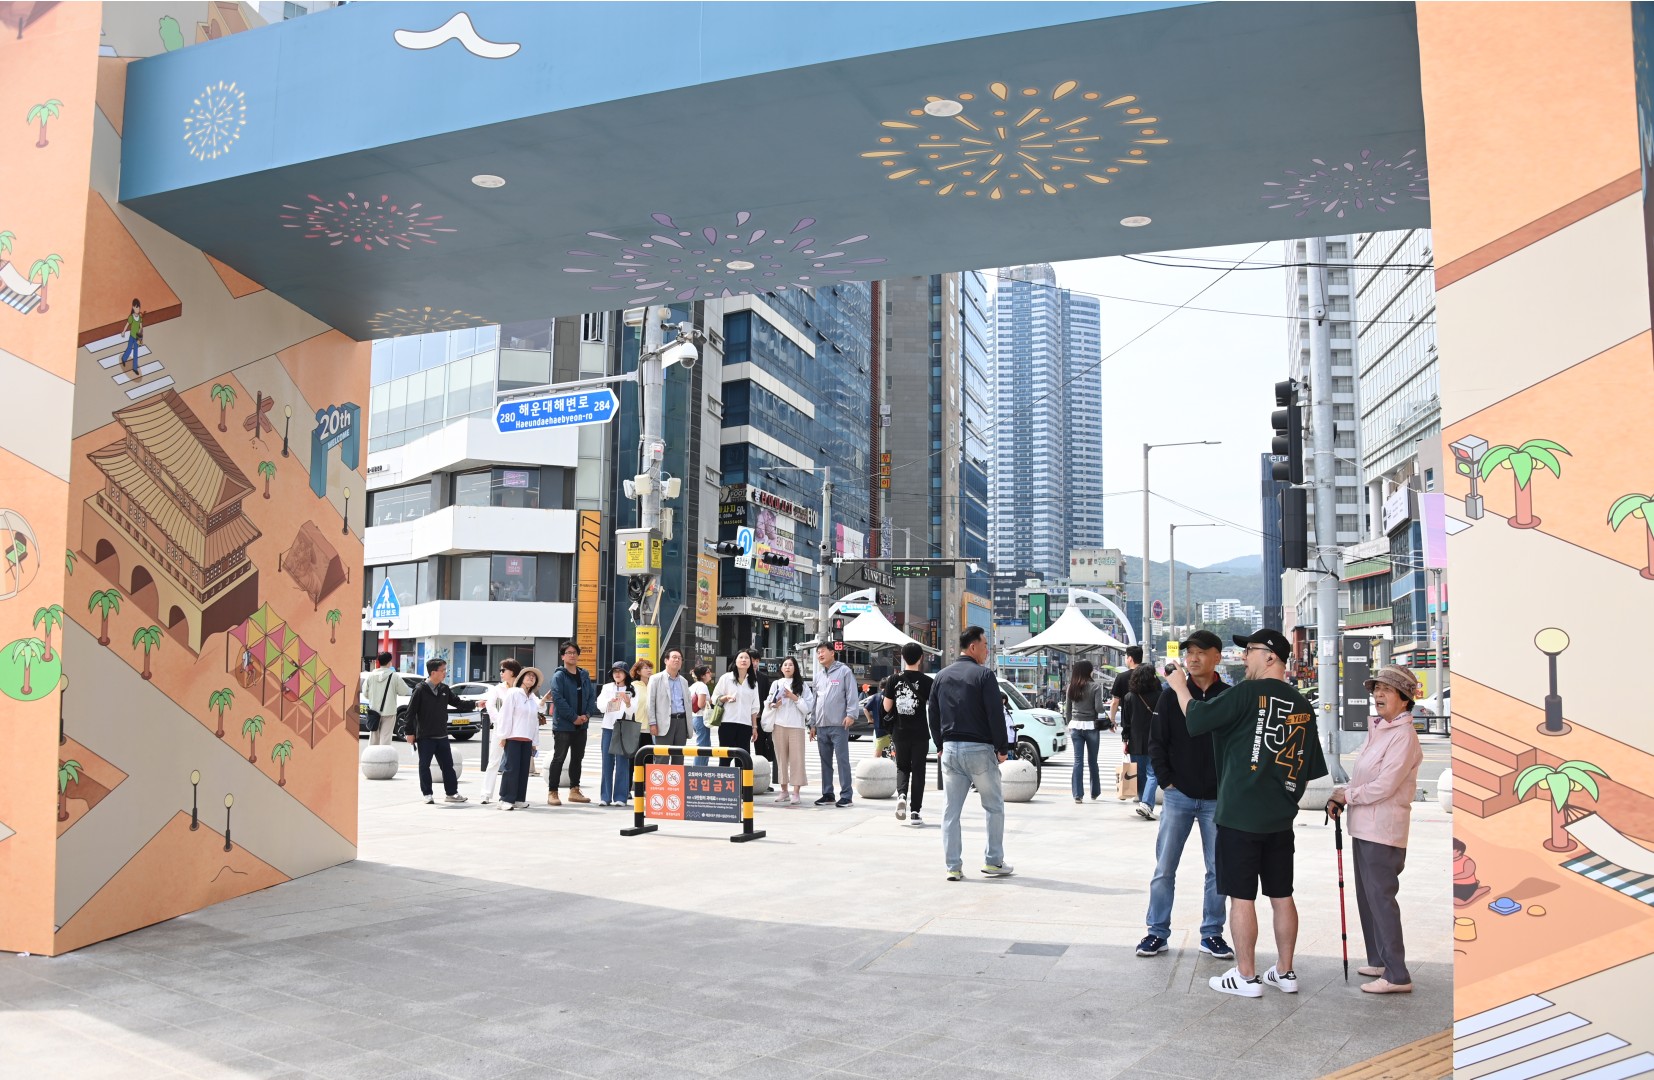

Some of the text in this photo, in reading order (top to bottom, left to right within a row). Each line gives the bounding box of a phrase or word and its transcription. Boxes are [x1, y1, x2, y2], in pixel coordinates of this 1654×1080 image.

[500, 395, 611, 424] 280 해운대해변로 284
[515, 412, 593, 429] Haeundaehaebyeon-ro
[320, 409, 351, 441] 20th
[327, 428, 350, 450] WELCOME
[581, 515, 601, 553] 277
[375, 608, 398, 618] 횡단보도
[1293, 713, 1310, 723] YEARS
[1250, 709, 1266, 763] OF BEING AWESOME
[688, 778, 735, 793] 진입금지
